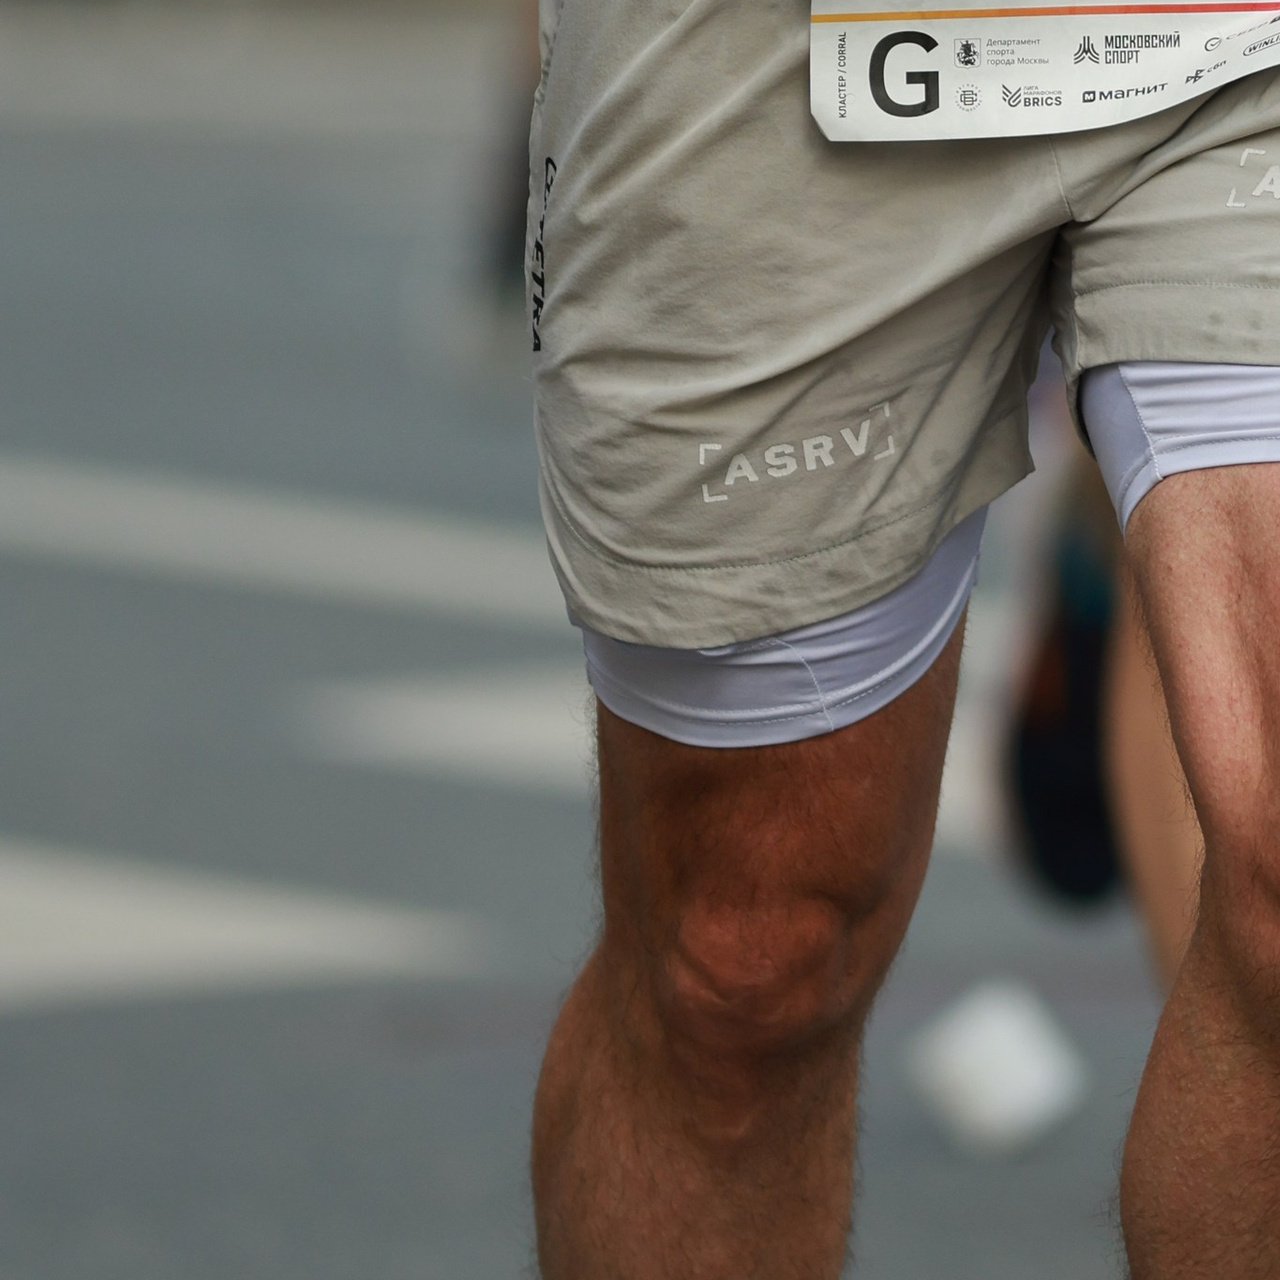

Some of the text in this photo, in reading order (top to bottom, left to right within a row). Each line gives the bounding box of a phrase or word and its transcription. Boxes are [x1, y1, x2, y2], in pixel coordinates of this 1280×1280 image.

[838, 31, 846, 67] CORRAL
[986, 39, 1041, 47] Департамент
[1104, 31, 1181, 49] МОСКОВСКИЙ
[986, 57, 1050, 66] города Москвы
[1104, 50, 1141, 64] СПОРТ
[868, 30, 940, 118] G
[838, 75, 846, 118] КЛАСТЕР
[1023, 96, 1062, 107] BRICS
[724, 419, 871, 485] ASRV
